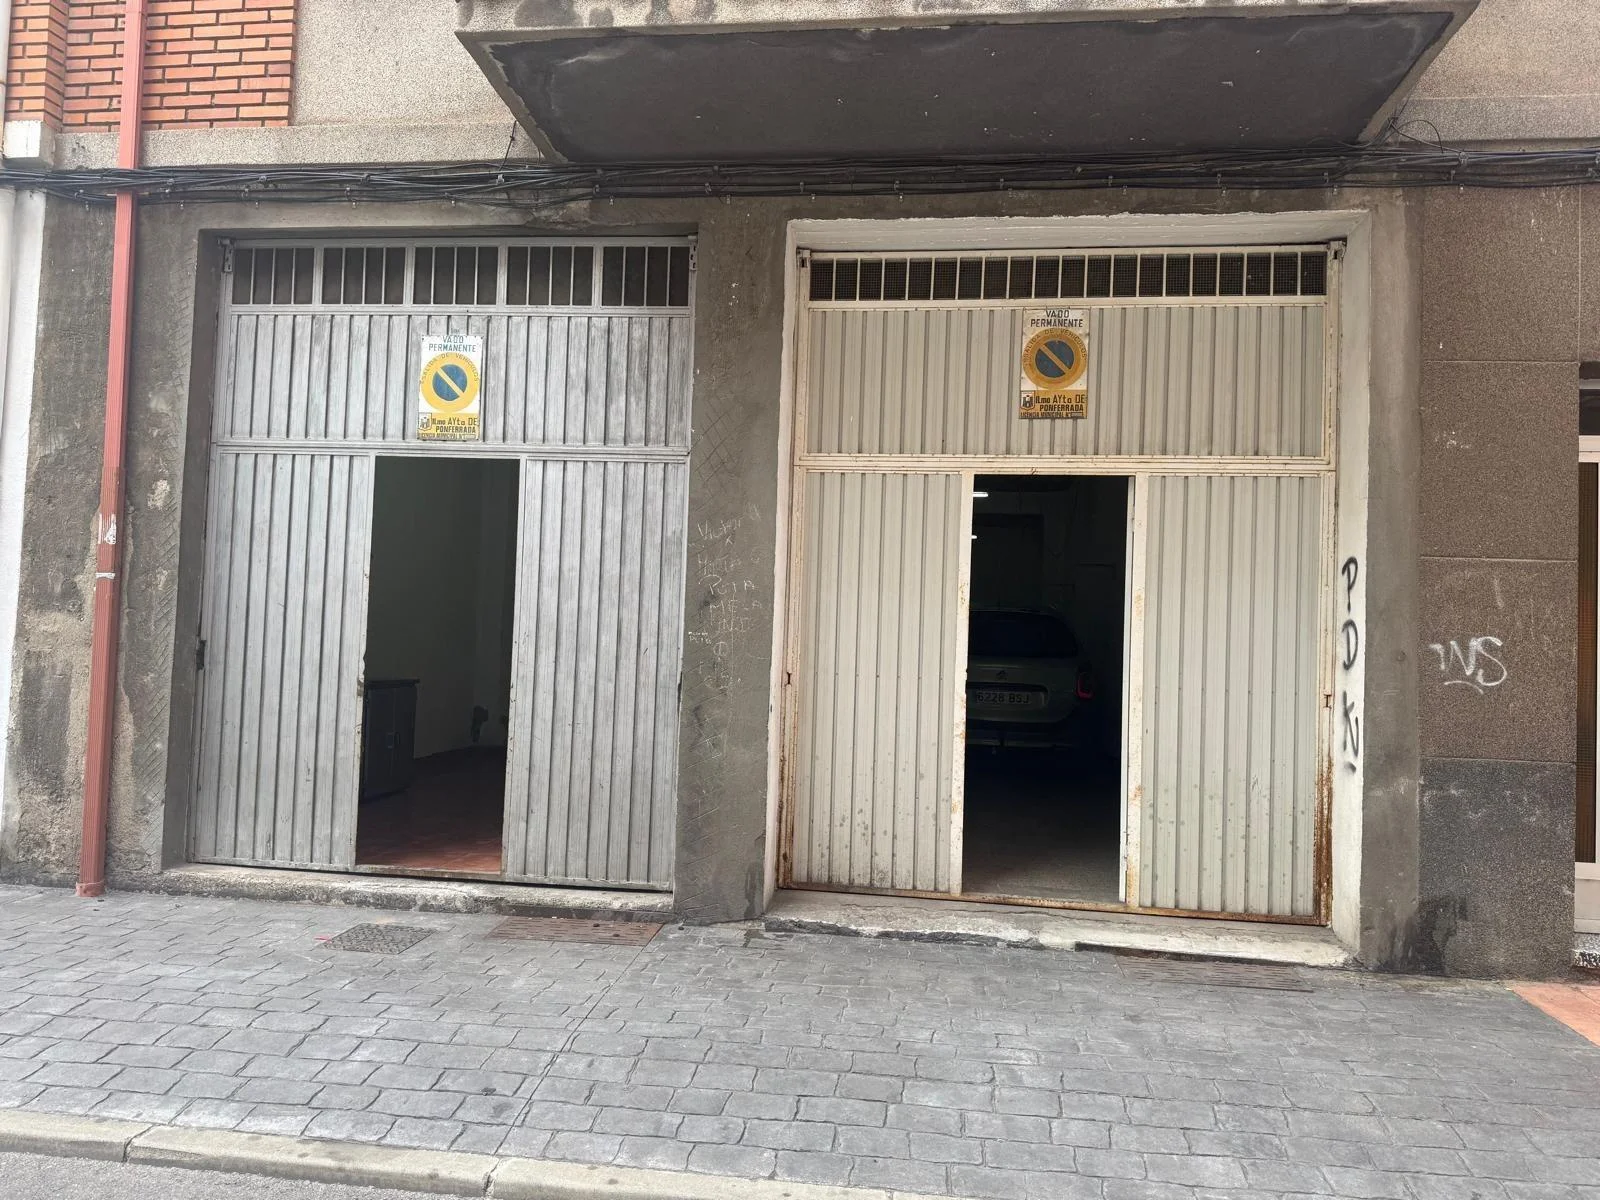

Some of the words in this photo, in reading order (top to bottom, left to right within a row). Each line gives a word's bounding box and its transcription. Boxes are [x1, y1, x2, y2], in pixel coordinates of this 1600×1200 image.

[1046, 309, 1070, 318] VADO
[1030, 318, 1083, 328] PERMANENTE
[442, 335, 464, 344] VADO
[428, 343, 477, 352] PERMANENTE
[1075, 394, 1086, 404] DE
[1039, 404, 1084, 412] PONFERRADA
[467, 416, 478, 426] DE
[435, 425, 476, 433] PONFERRADA
